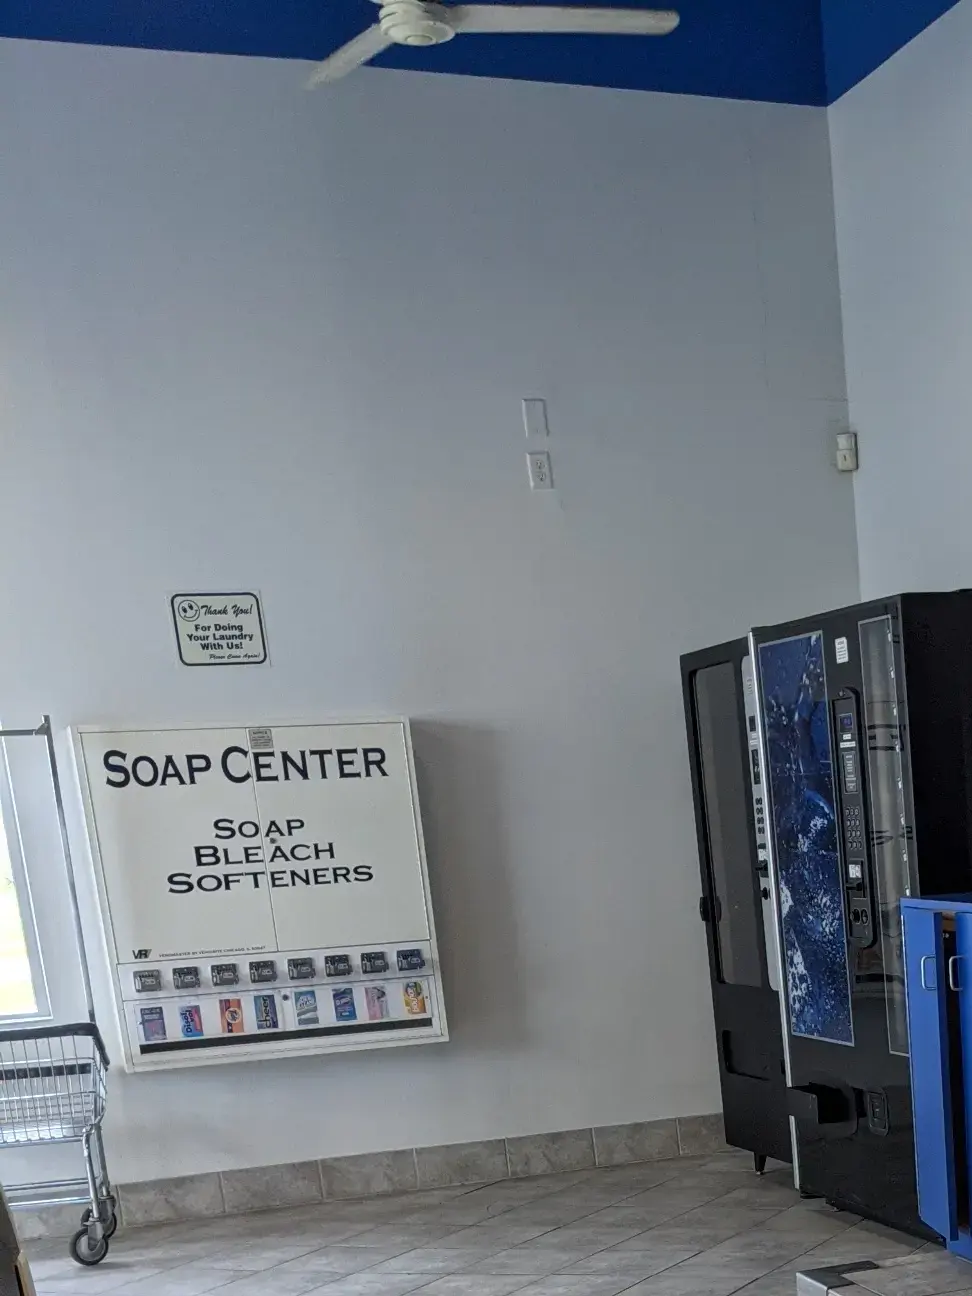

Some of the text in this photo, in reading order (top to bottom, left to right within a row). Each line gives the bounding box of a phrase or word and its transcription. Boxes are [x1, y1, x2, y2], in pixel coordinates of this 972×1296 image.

[200, 604, 253, 618] Thank You!
[194, 623, 243, 632] For Doing
[186, 632, 254, 642] Your Laundry
[200, 641, 244, 650] With Us!
[103, 745, 389, 788] SOAP CENTER
[213, 818, 305, 839] SOAP
[194, 842, 335, 867] BLEACH
[167, 865, 374, 894] SOFTENERS
